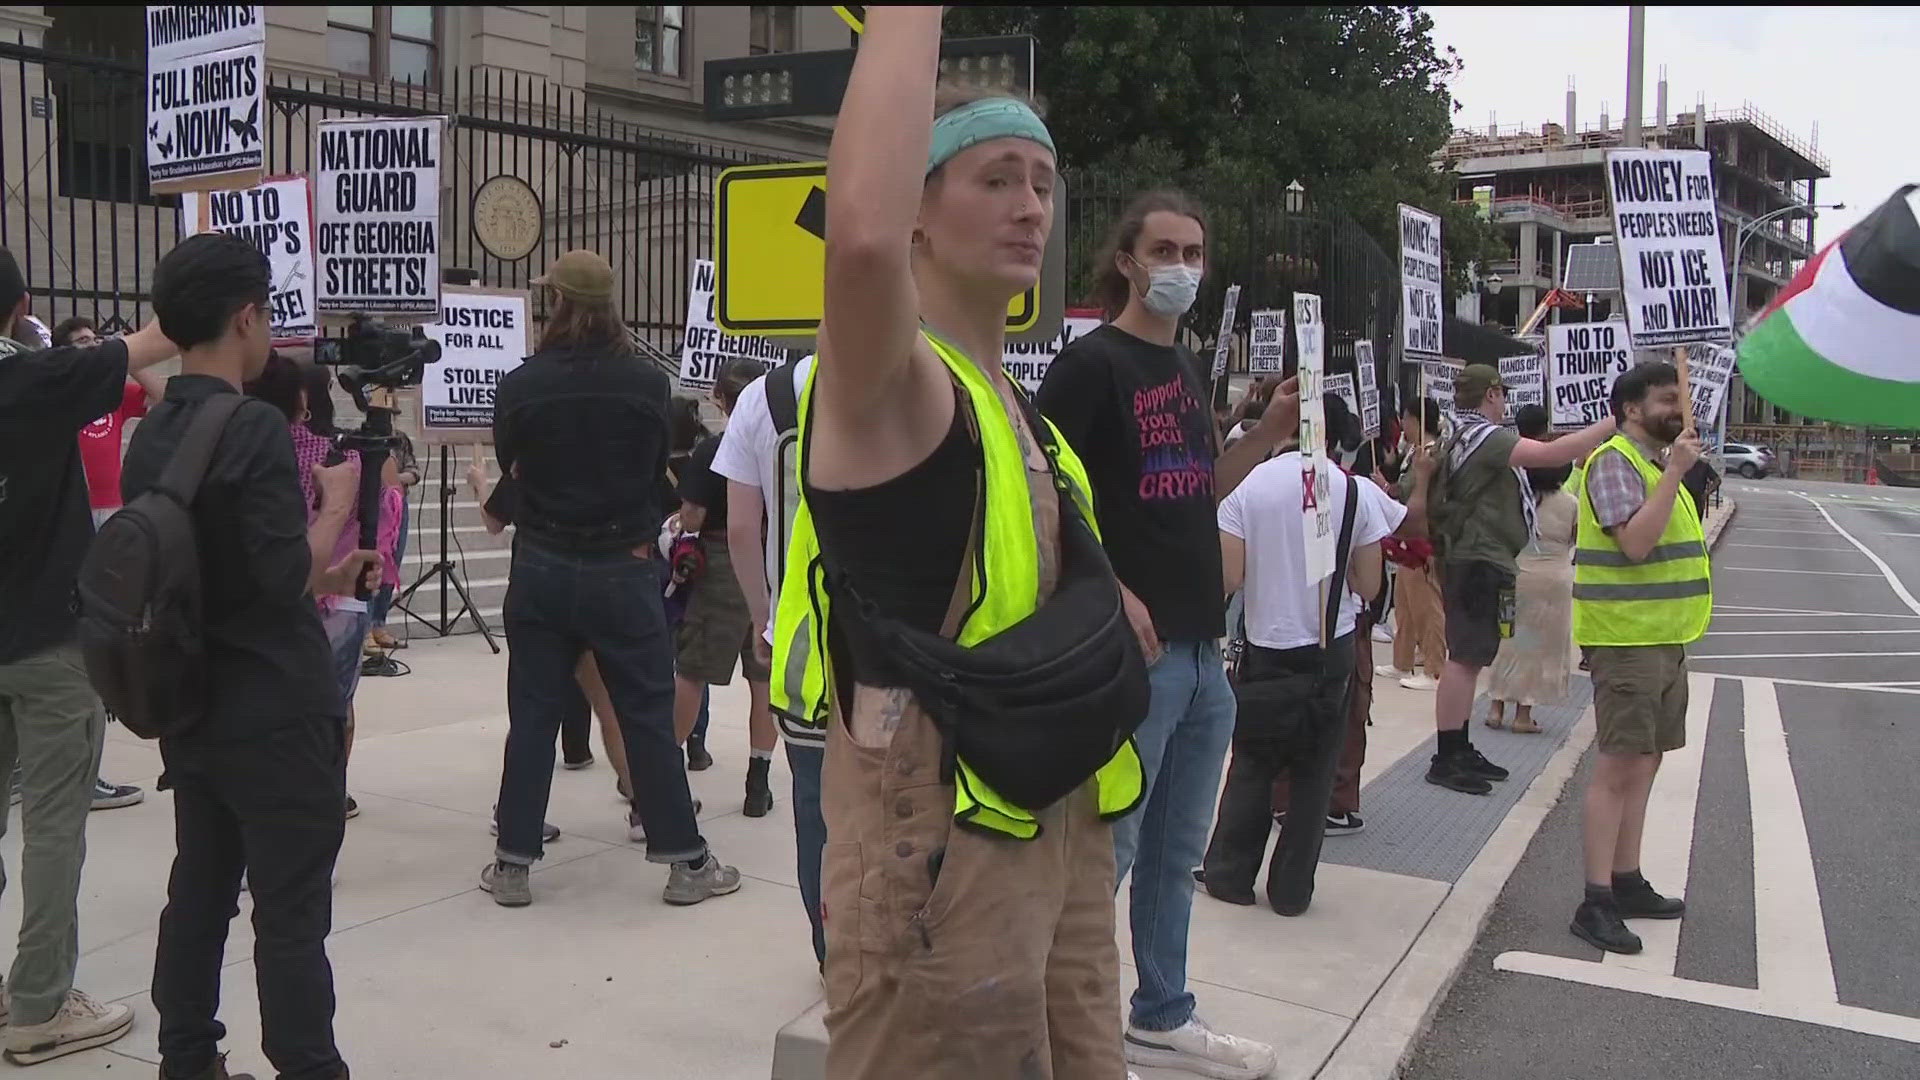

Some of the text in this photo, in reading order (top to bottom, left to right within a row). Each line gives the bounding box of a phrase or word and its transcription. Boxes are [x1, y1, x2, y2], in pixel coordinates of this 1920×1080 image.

[152, 55, 256, 112] FULL RIGHTS
[176, 106, 231, 160] NOW!
[321, 128, 435, 171] NATIONAL
[336, 171, 416, 213] GUARD
[1612, 160, 1710, 202] MONEY FOR
[211, 188, 279, 226] NO TO
[319, 221, 435, 254] OFF GEORGIA
[1403, 215, 1430, 255] MONEY
[1619, 211, 1714, 238] PEOPLE'S NEEDS
[326, 257, 426, 296] STREETS!
[1404, 256, 1425, 280] PEOPLE'S
[1639, 249, 1711, 289] NOT ICE
[1410, 286, 1424, 317] NOT
[1642, 287, 1719, 331] AND WAR!
[445, 333, 503, 349] FOR ALL
[687, 327, 717, 350] OFF
[1409, 320, 1439, 350] AND WAR!
[1567, 328, 1590, 351] NO
[1592, 327, 1614, 350] TO
[444, 367, 506, 387] STOLEN
[1501, 358, 1525, 374] HANDS
[1556, 350, 1628, 376] TRUMP'S
[449, 387, 496, 405] LIVES
[1133, 373, 1183, 416] Support
[1556, 377, 1609, 407] POLICE
[1138, 413, 1177, 431] YOUR
[1140, 429, 1184, 448] LOCAL
